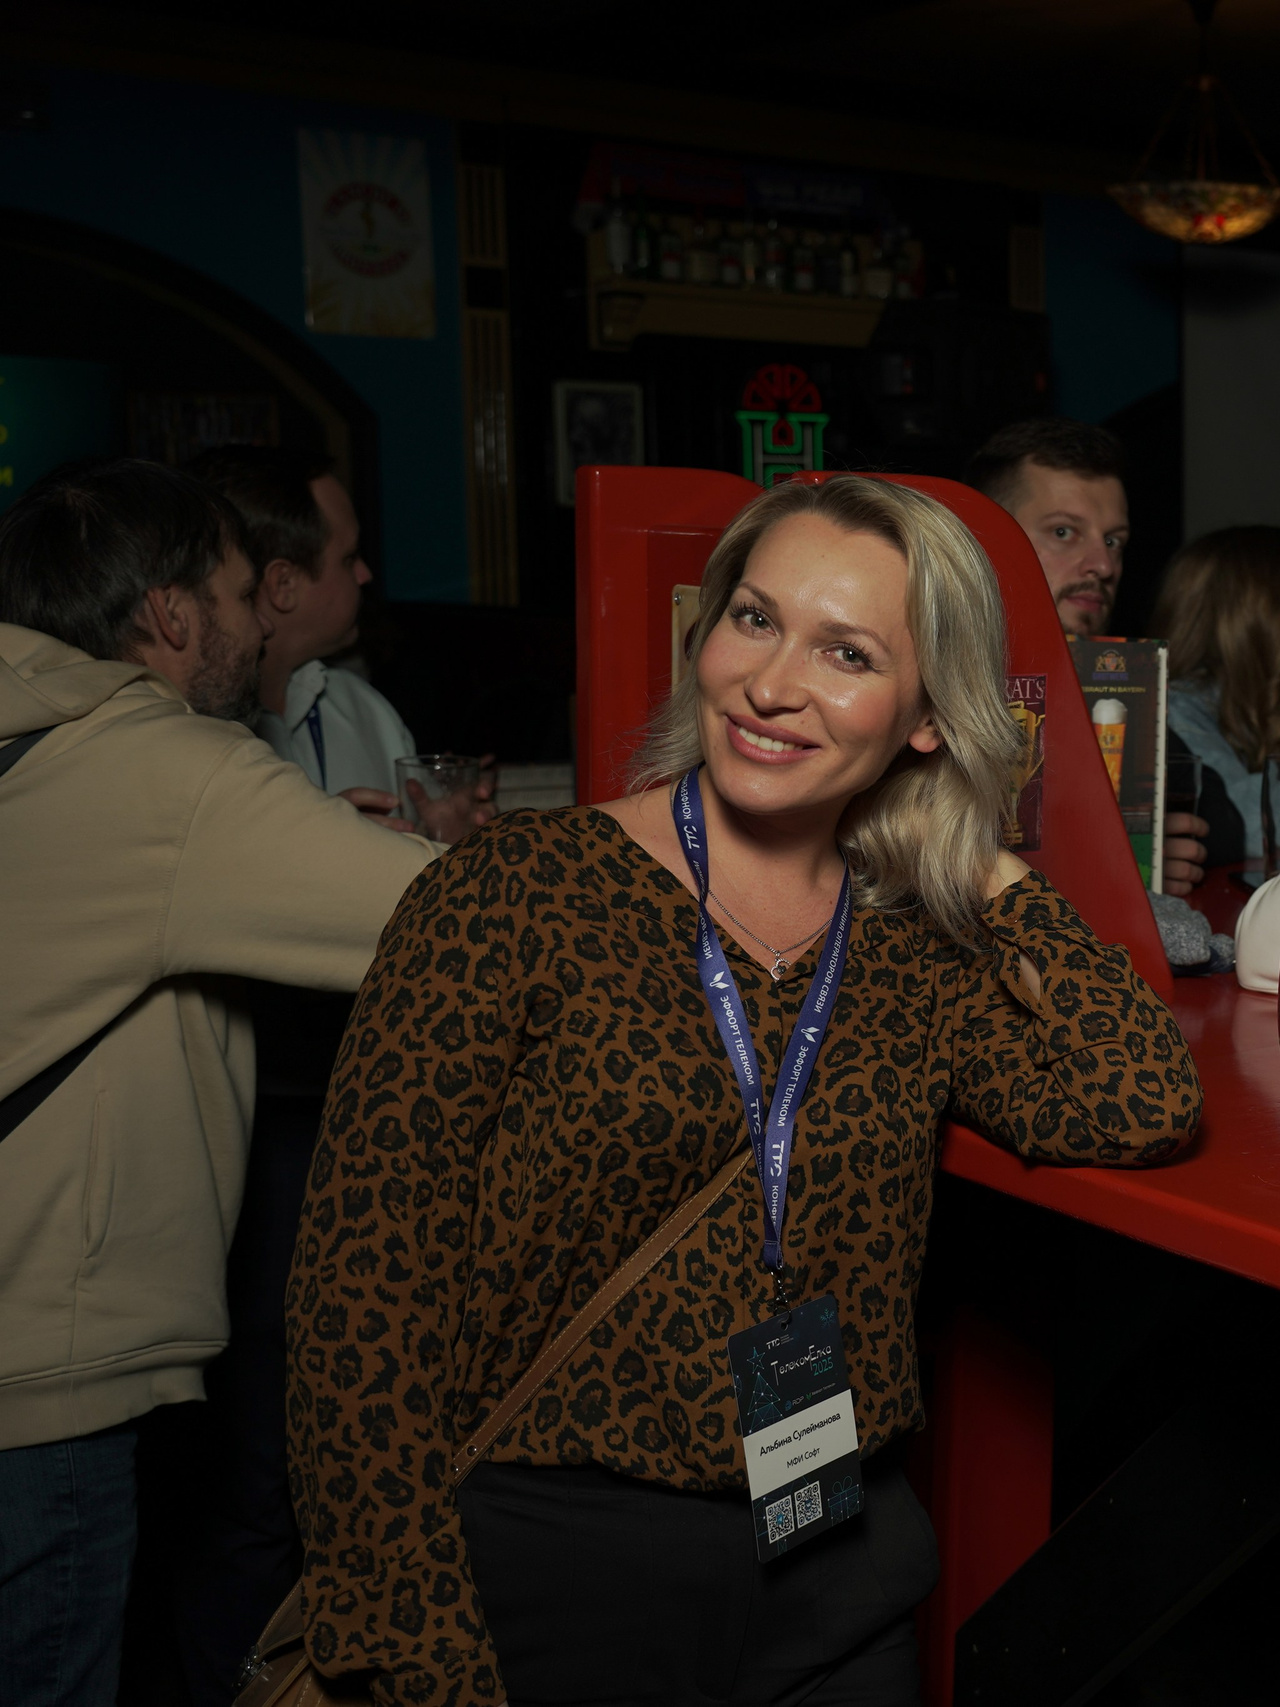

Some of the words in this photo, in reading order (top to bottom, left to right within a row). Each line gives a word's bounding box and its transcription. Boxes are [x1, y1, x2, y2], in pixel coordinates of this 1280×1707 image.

[701, 930, 713, 960] СВЯЗИ
[824, 931, 844, 984] ОПЕРАТОРОВ
[814, 984, 830, 1014] СВЯЗИ
[720, 995, 741, 1037] ЭФФОРТ
[734, 1035, 755, 1086] ТЕЛЕКОМ
[790, 1045, 809, 1082] ЭФФОРТ
[777, 1083, 797, 1127] ТЕЛЕКОМ
[812, 1357, 834, 1376] 2025
[760, 1436, 792, 1456] Альбина
[792, 1413, 841, 1441] Сулейманова
[786, 1453, 804, 1468] МФИ
[804, 1447, 820, 1460] Софт
